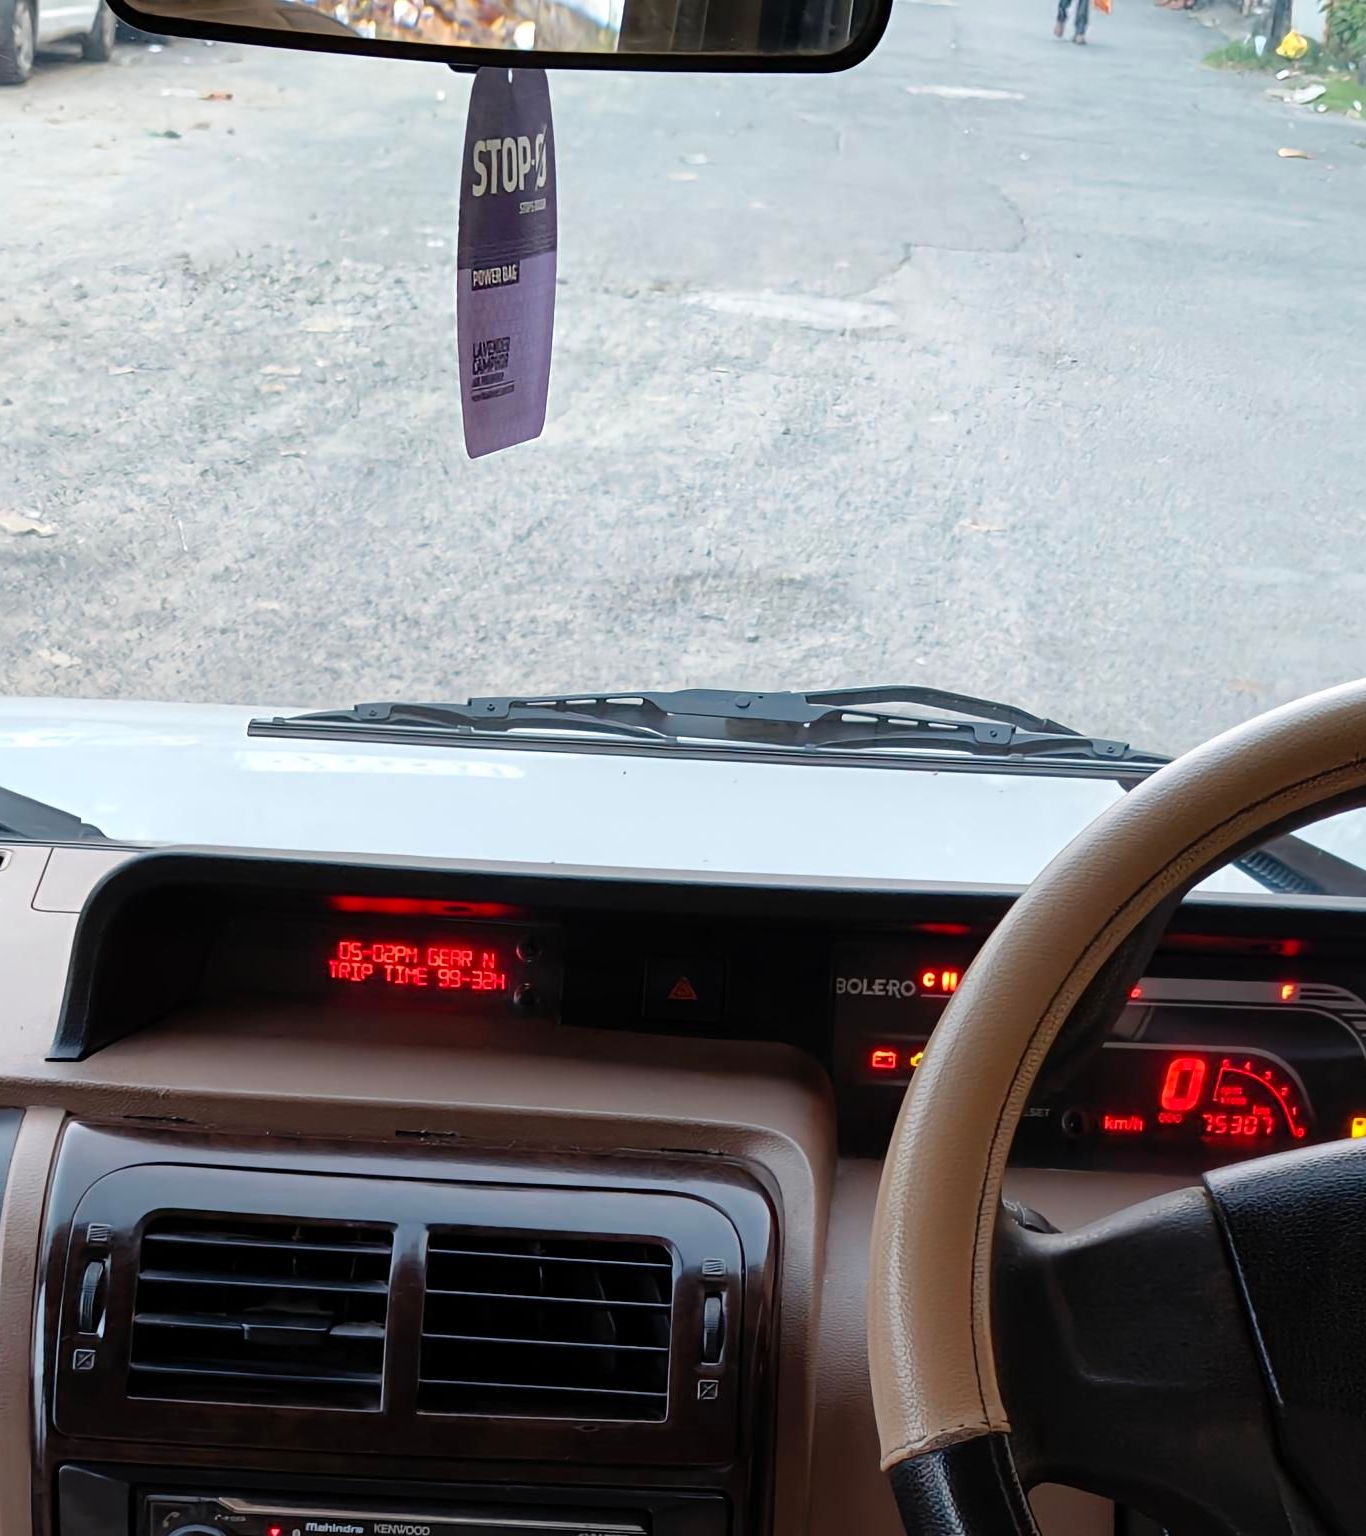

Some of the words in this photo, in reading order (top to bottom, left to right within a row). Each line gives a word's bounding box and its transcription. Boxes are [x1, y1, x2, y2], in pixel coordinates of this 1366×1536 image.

[473, 266, 502, 286] POWER
[502, 263, 518, 281] BAG
[427, 947, 473, 968] GEAR
[482, 952, 495, 969] N
[329, 960, 373, 982] TRIP
[384, 965, 428, 987] TIME
[438, 968, 506, 991] 99-32H
[835, 978, 917, 999] BOLERO
[1281, 984, 1294, 1000] F
[1161, 1058, 1206, 1111] 0
[1104, 1115, 1144, 1132] km/h
[1203, 1113, 1275, 1135] 75307
[373, 1523, 431, 1536] KENWOOD
